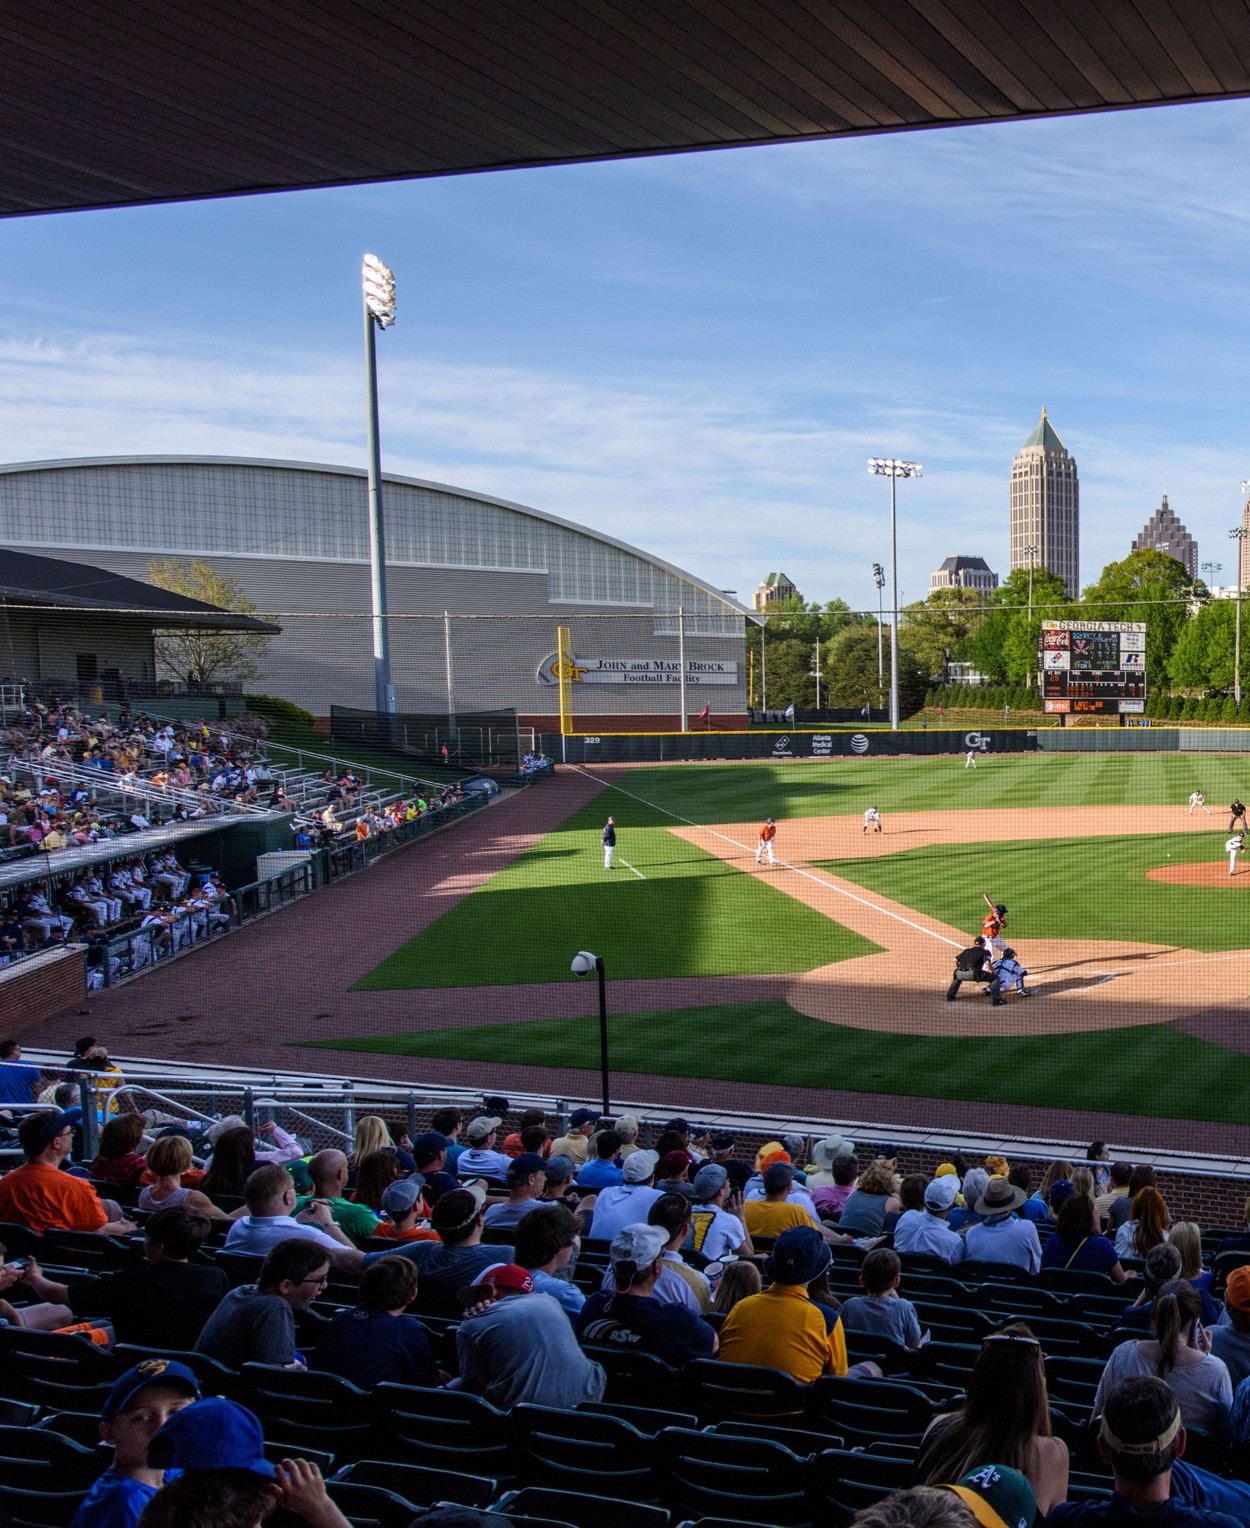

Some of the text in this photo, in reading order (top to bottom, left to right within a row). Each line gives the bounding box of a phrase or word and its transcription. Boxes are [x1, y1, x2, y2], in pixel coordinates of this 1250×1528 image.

[1060, 621, 1134, 632] GEORGIA TECH
[597, 660, 627, 670] JOHN
[630, 660, 650, 670] and
[689, 661, 724, 671] BROCK
[624, 673, 663, 682] Football
[584, 736, 600, 744] 329
[965, 731, 991, 750] GT
[967, 1465, 1001, 1489] A's
